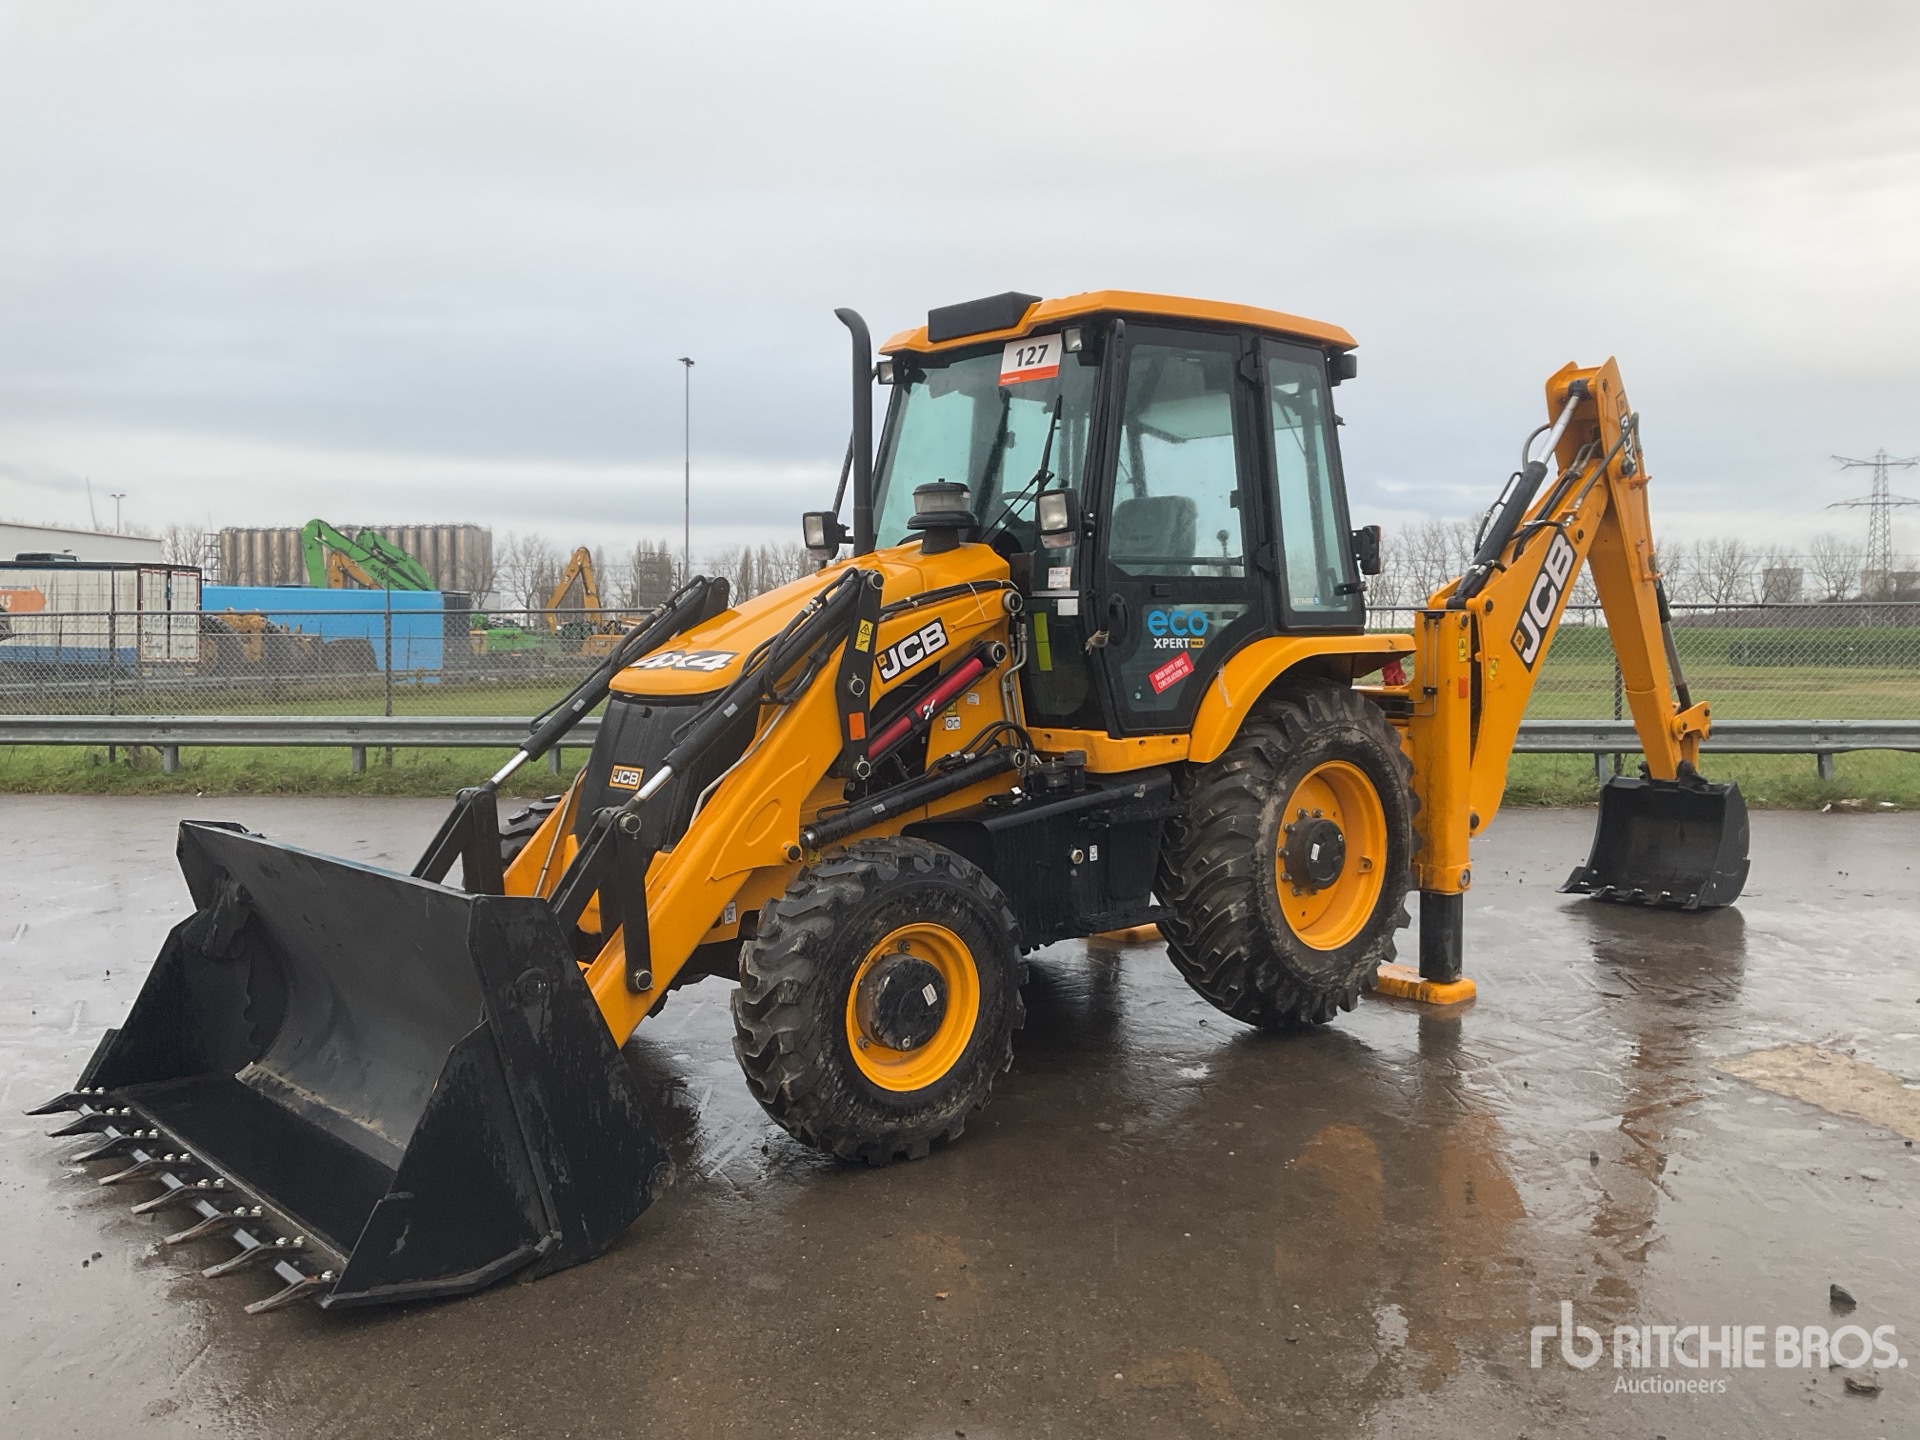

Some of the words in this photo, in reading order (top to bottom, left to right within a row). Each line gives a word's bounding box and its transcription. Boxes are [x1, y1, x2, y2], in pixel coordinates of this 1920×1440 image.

[1016, 344, 1049, 367] 127
[1522, 533, 1574, 664] JCB
[1147, 610, 1208, 636] eco
[881, 622, 947, 679] JCB
[1153, 638, 1190, 649] XPERT
[613, 770, 639, 786] JCB
